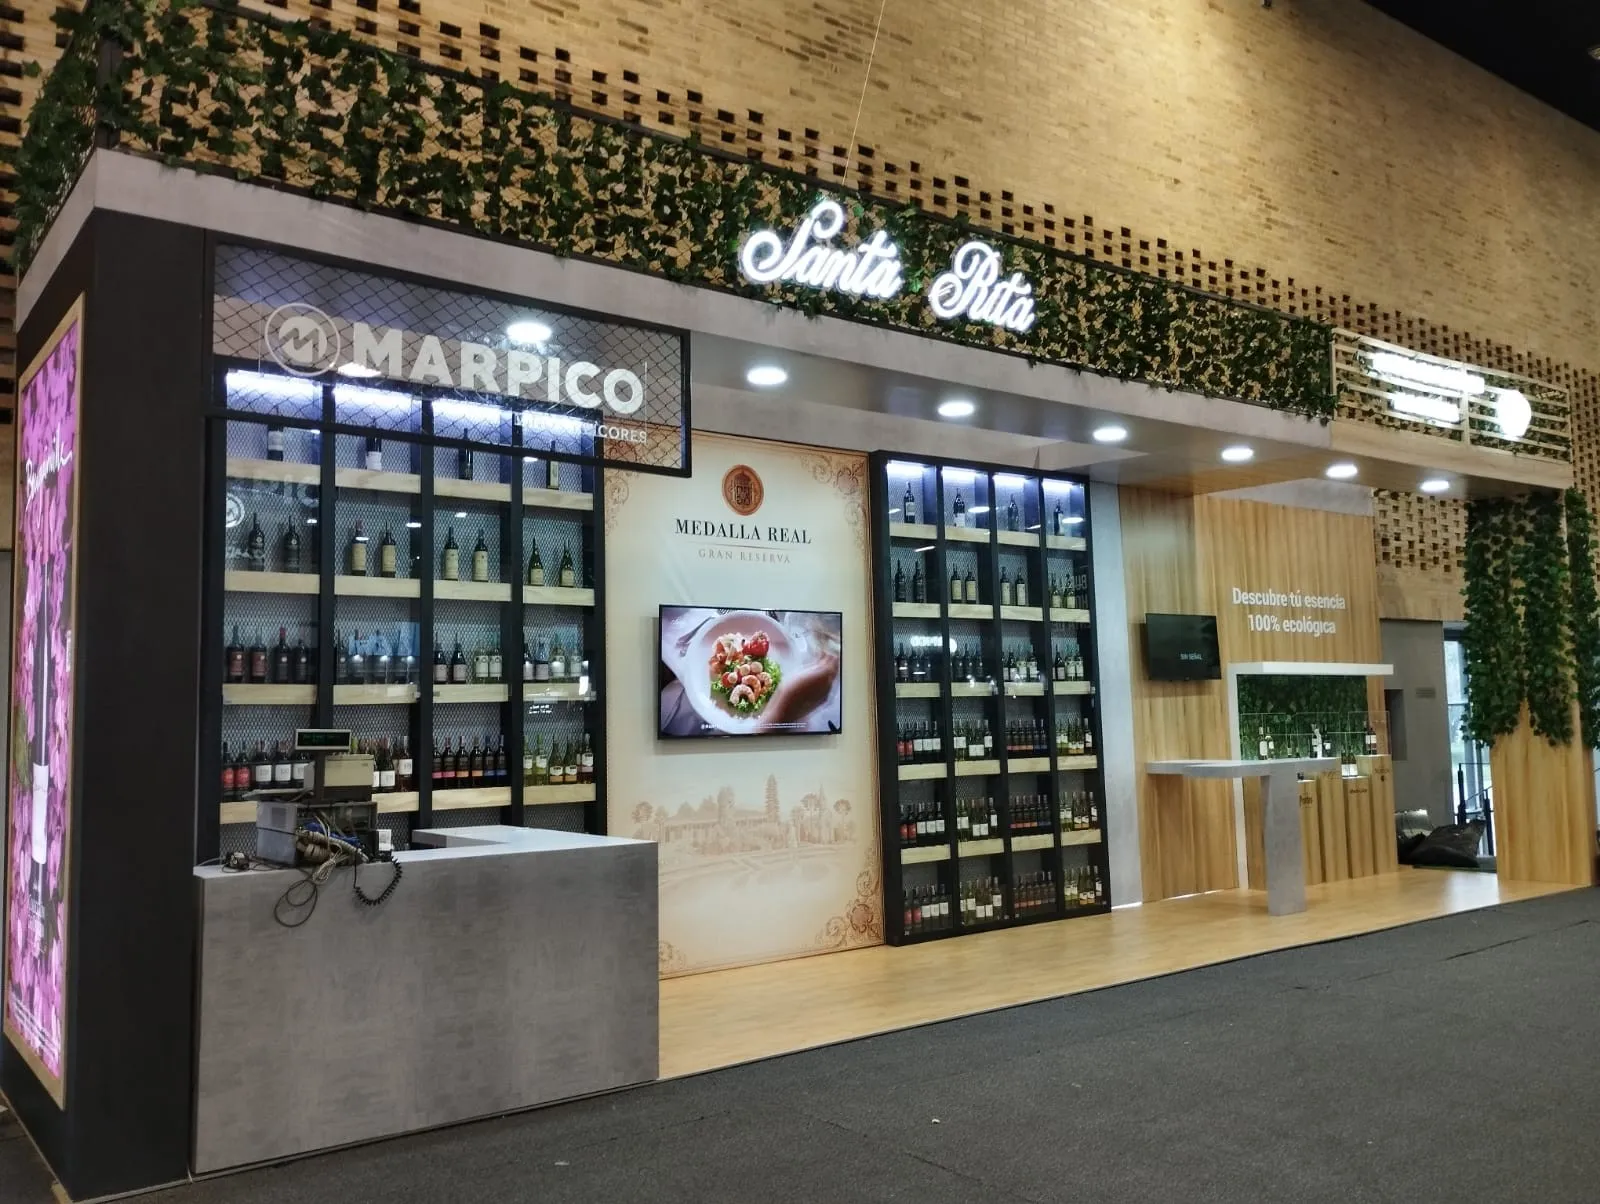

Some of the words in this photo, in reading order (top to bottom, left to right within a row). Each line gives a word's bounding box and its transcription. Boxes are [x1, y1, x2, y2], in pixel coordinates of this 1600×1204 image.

[741, 200, 904, 299] Santa
[928, 241, 1035, 332] Rita
[353, 321, 644, 415] MARPICO
[674, 518, 761, 541] MEDALLA
[767, 526, 812, 545] REAL
[698, 548, 734, 560] GRAN
[739, 551, 792, 565] RESERVA
[1232, 587, 1288, 607] Descubre
[1290, 589, 1302, 608] tú
[1304, 594, 1346, 610] esencia
[1247, 614, 1281, 632] 100%
[1282, 616, 1337, 637] ecológica
